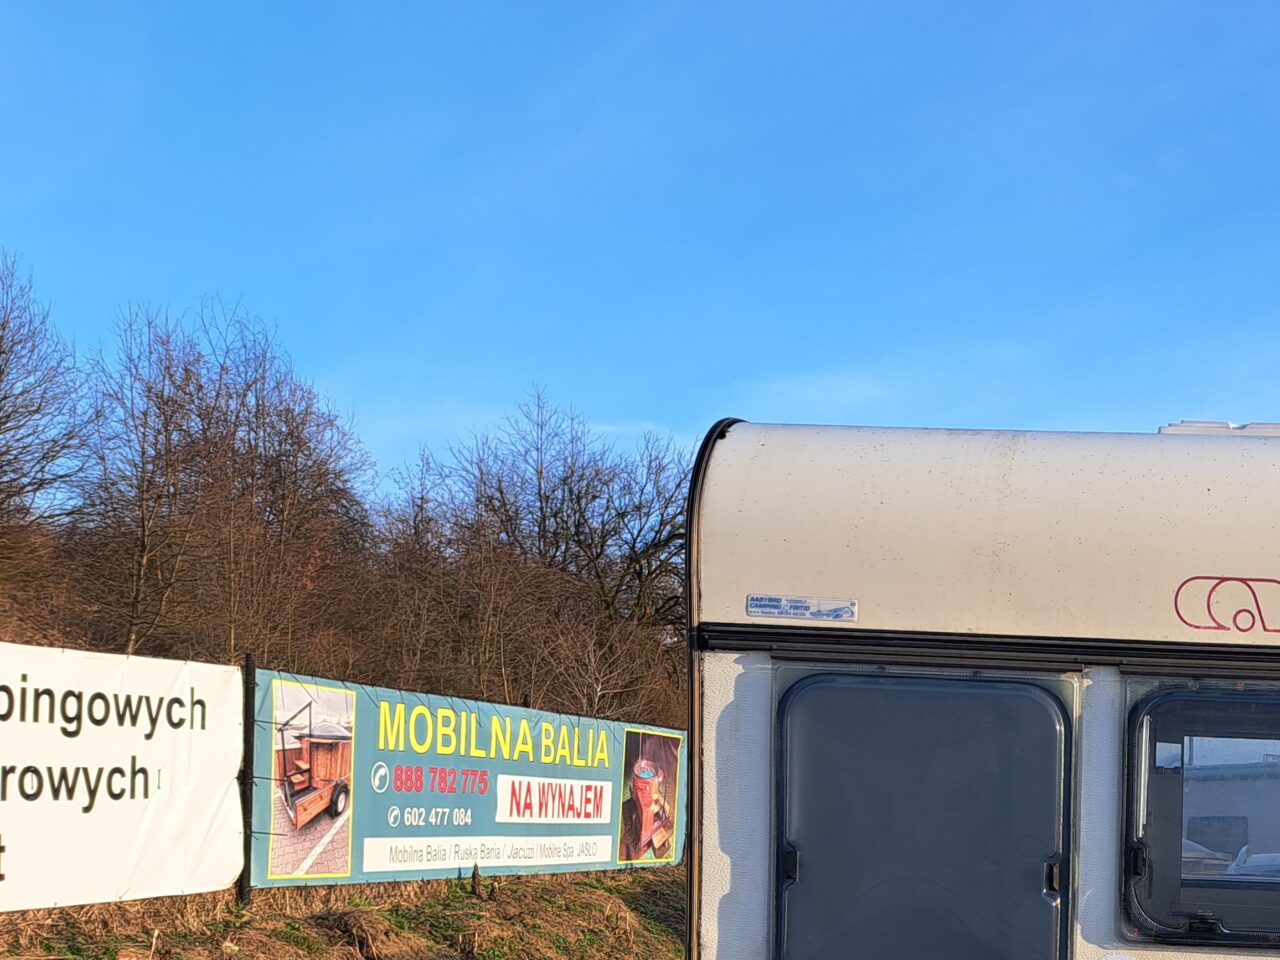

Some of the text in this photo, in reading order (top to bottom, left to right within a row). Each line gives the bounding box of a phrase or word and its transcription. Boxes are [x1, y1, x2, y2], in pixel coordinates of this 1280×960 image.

[378, 701, 610, 768] MOBILNA BALIA
[0, 755, 149, 814] rowych
[393, 765, 489, 795] 888 782 775
[404, 807, 472, 826] 602 477 084
[509, 780, 604, 819] NA WYNAJEM
[389, 845, 424, 863] Mobilna
[426, 844, 447, 862] Balia
[454, 843, 478, 861] Ruska
[480, 843, 501, 860] Bania
[562, 842, 574, 861] Spa
